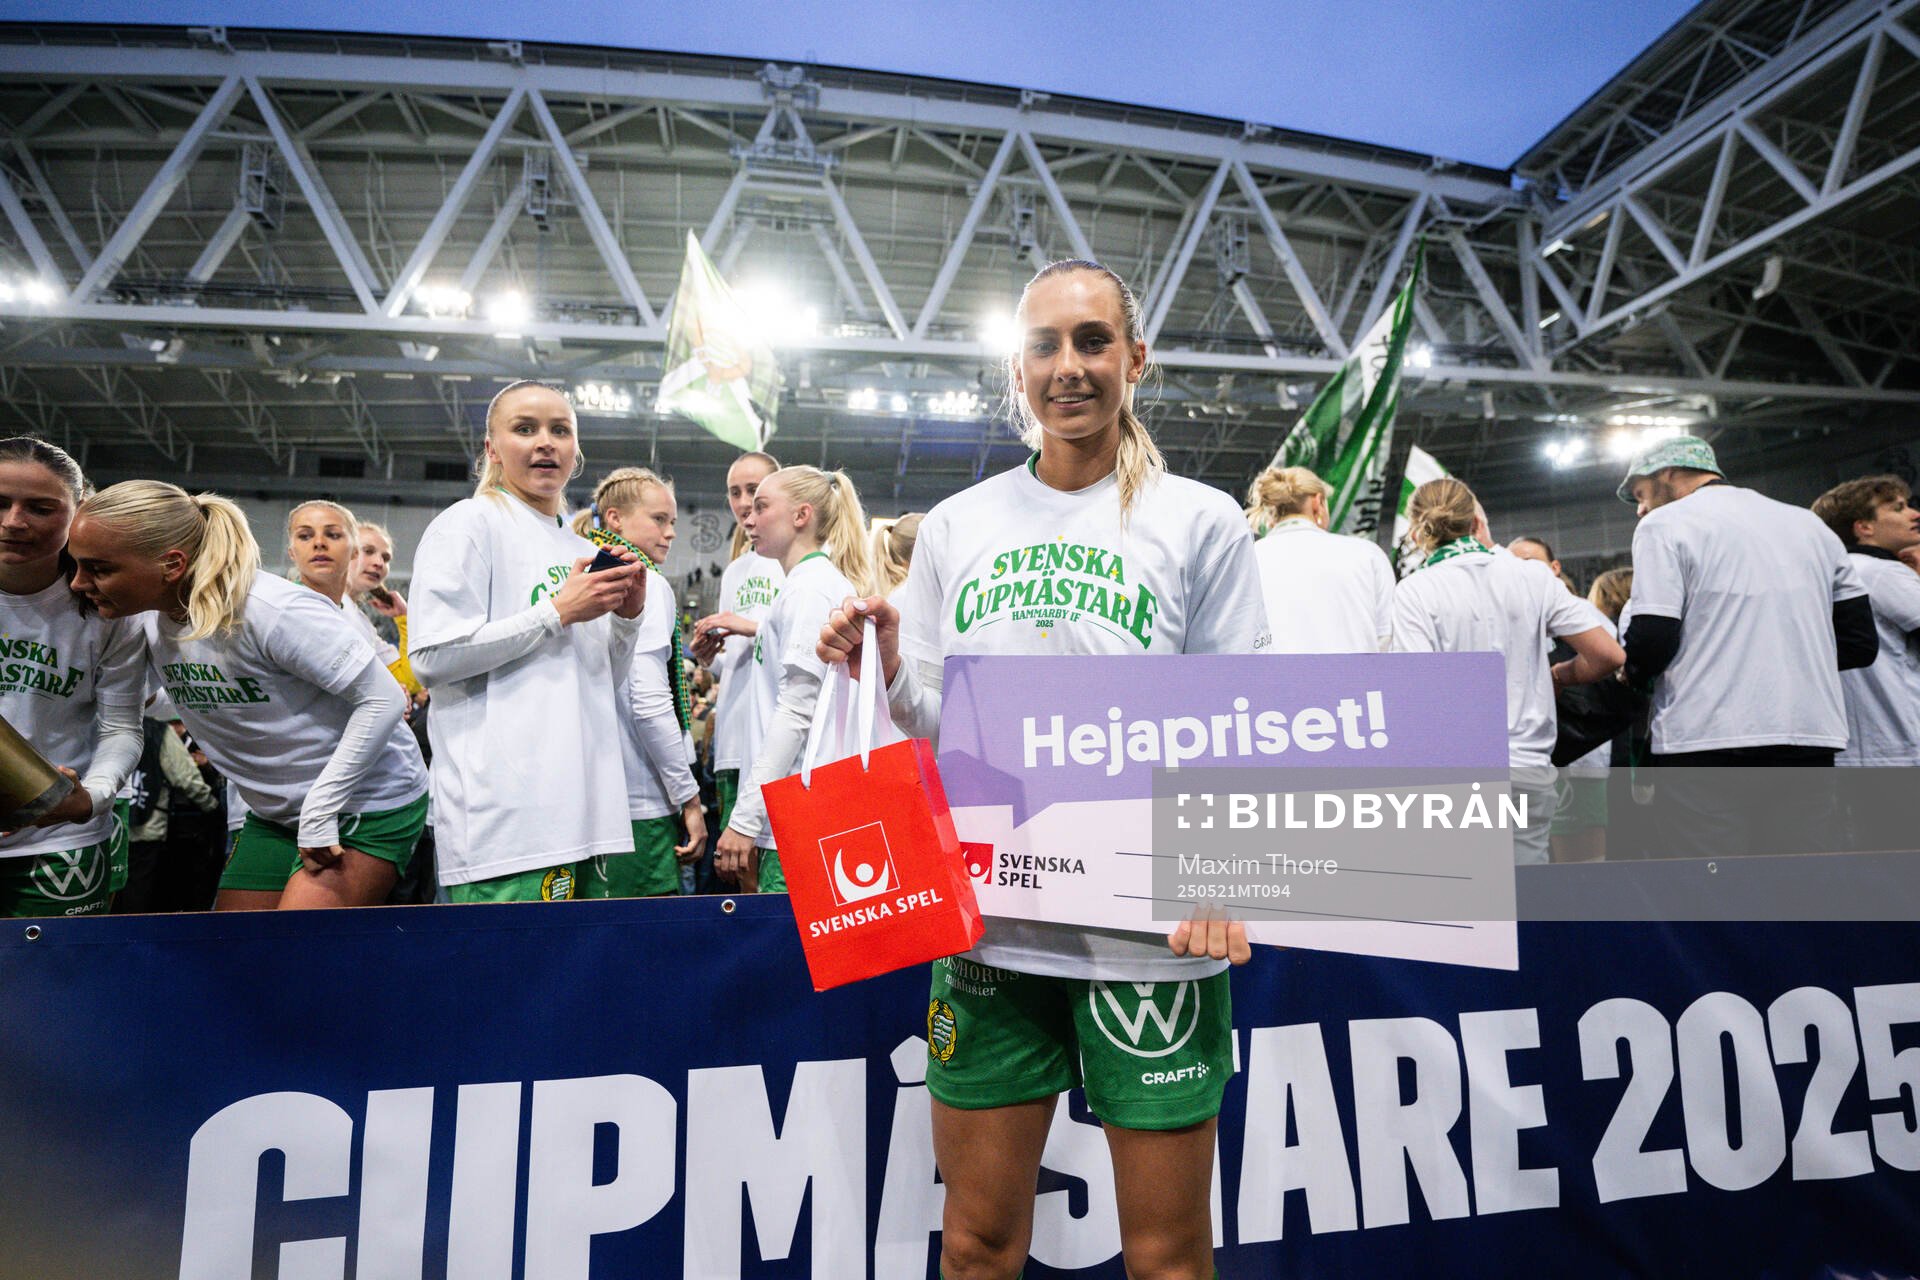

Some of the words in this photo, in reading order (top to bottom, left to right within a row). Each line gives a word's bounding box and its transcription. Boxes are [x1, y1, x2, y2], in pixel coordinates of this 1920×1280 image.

[990, 543, 1125, 586] SVENSKA
[955, 570, 1158, 650] CUPMÄSTARE
[1012, 608, 1069, 621] HAMMARBY
[1070, 612, 1082, 623] IF
[1035, 619, 1054, 628] 2025
[1023, 691, 1389, 777] Hejapriset!
[999, 853, 1086, 875] SVENSKA
[998, 871, 1043, 890] SPEL
[809, 902, 894, 938] SVENSKA
[896, 888, 943, 914] SPEL
[1141, 1066, 1196, 1085] CRAFT
[1577, 982, 1920, 1204] 2025
